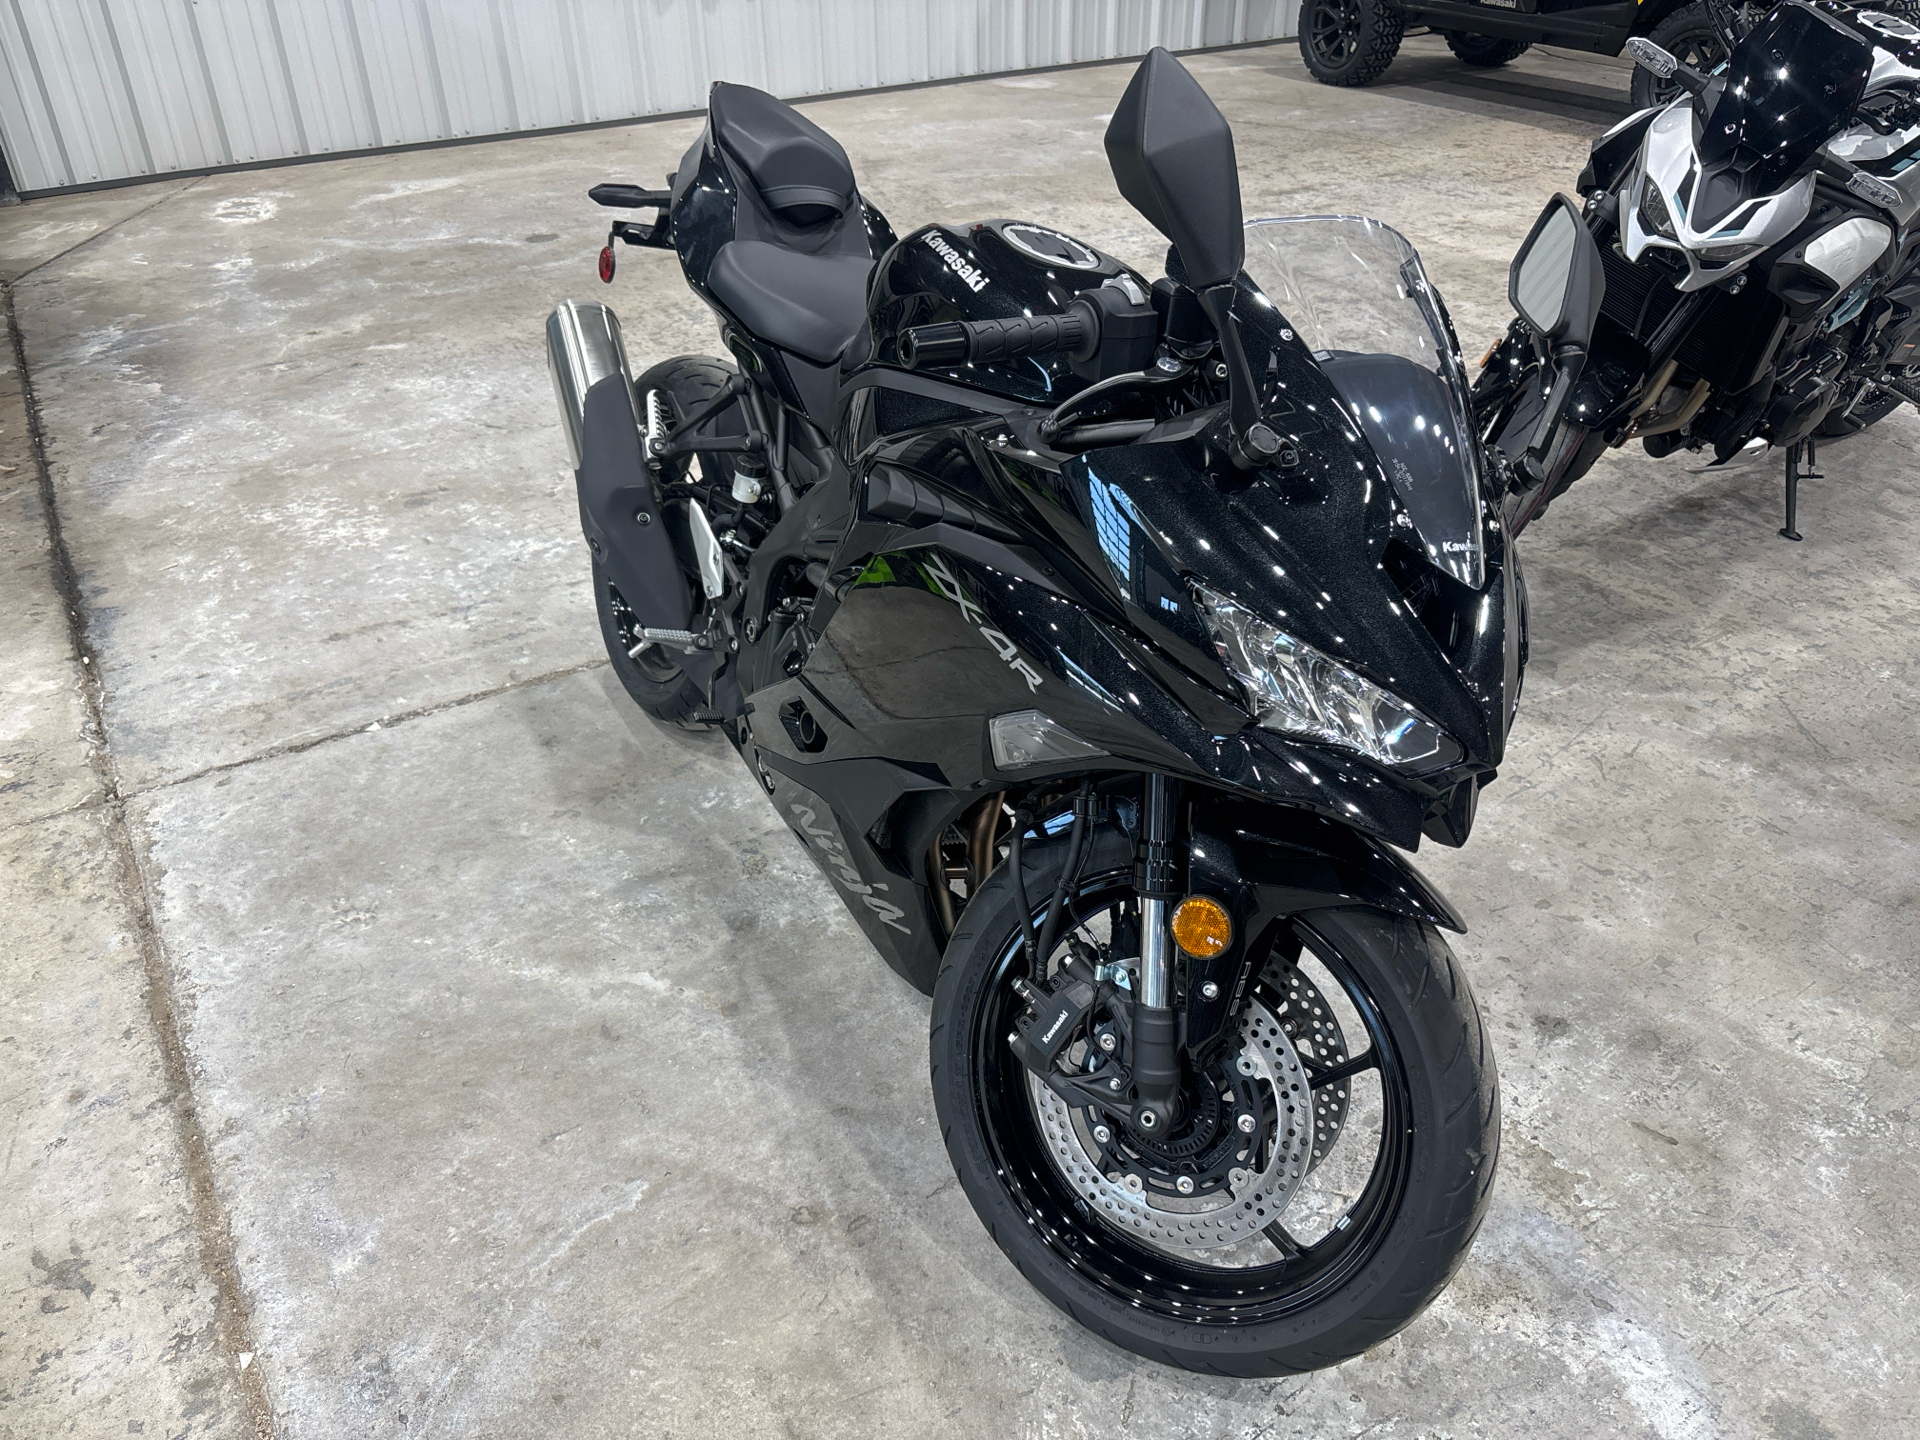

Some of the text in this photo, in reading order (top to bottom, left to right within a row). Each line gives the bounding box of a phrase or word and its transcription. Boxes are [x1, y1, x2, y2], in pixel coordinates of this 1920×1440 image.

[921, 229, 990, 292] Kawasaki
[921, 553, 1043, 695] ZX-4R
[790, 804, 912, 935] Ninja
[1229, 961, 1252, 1016] ABS
[1041, 1009, 1069, 1044] Kawasaki
